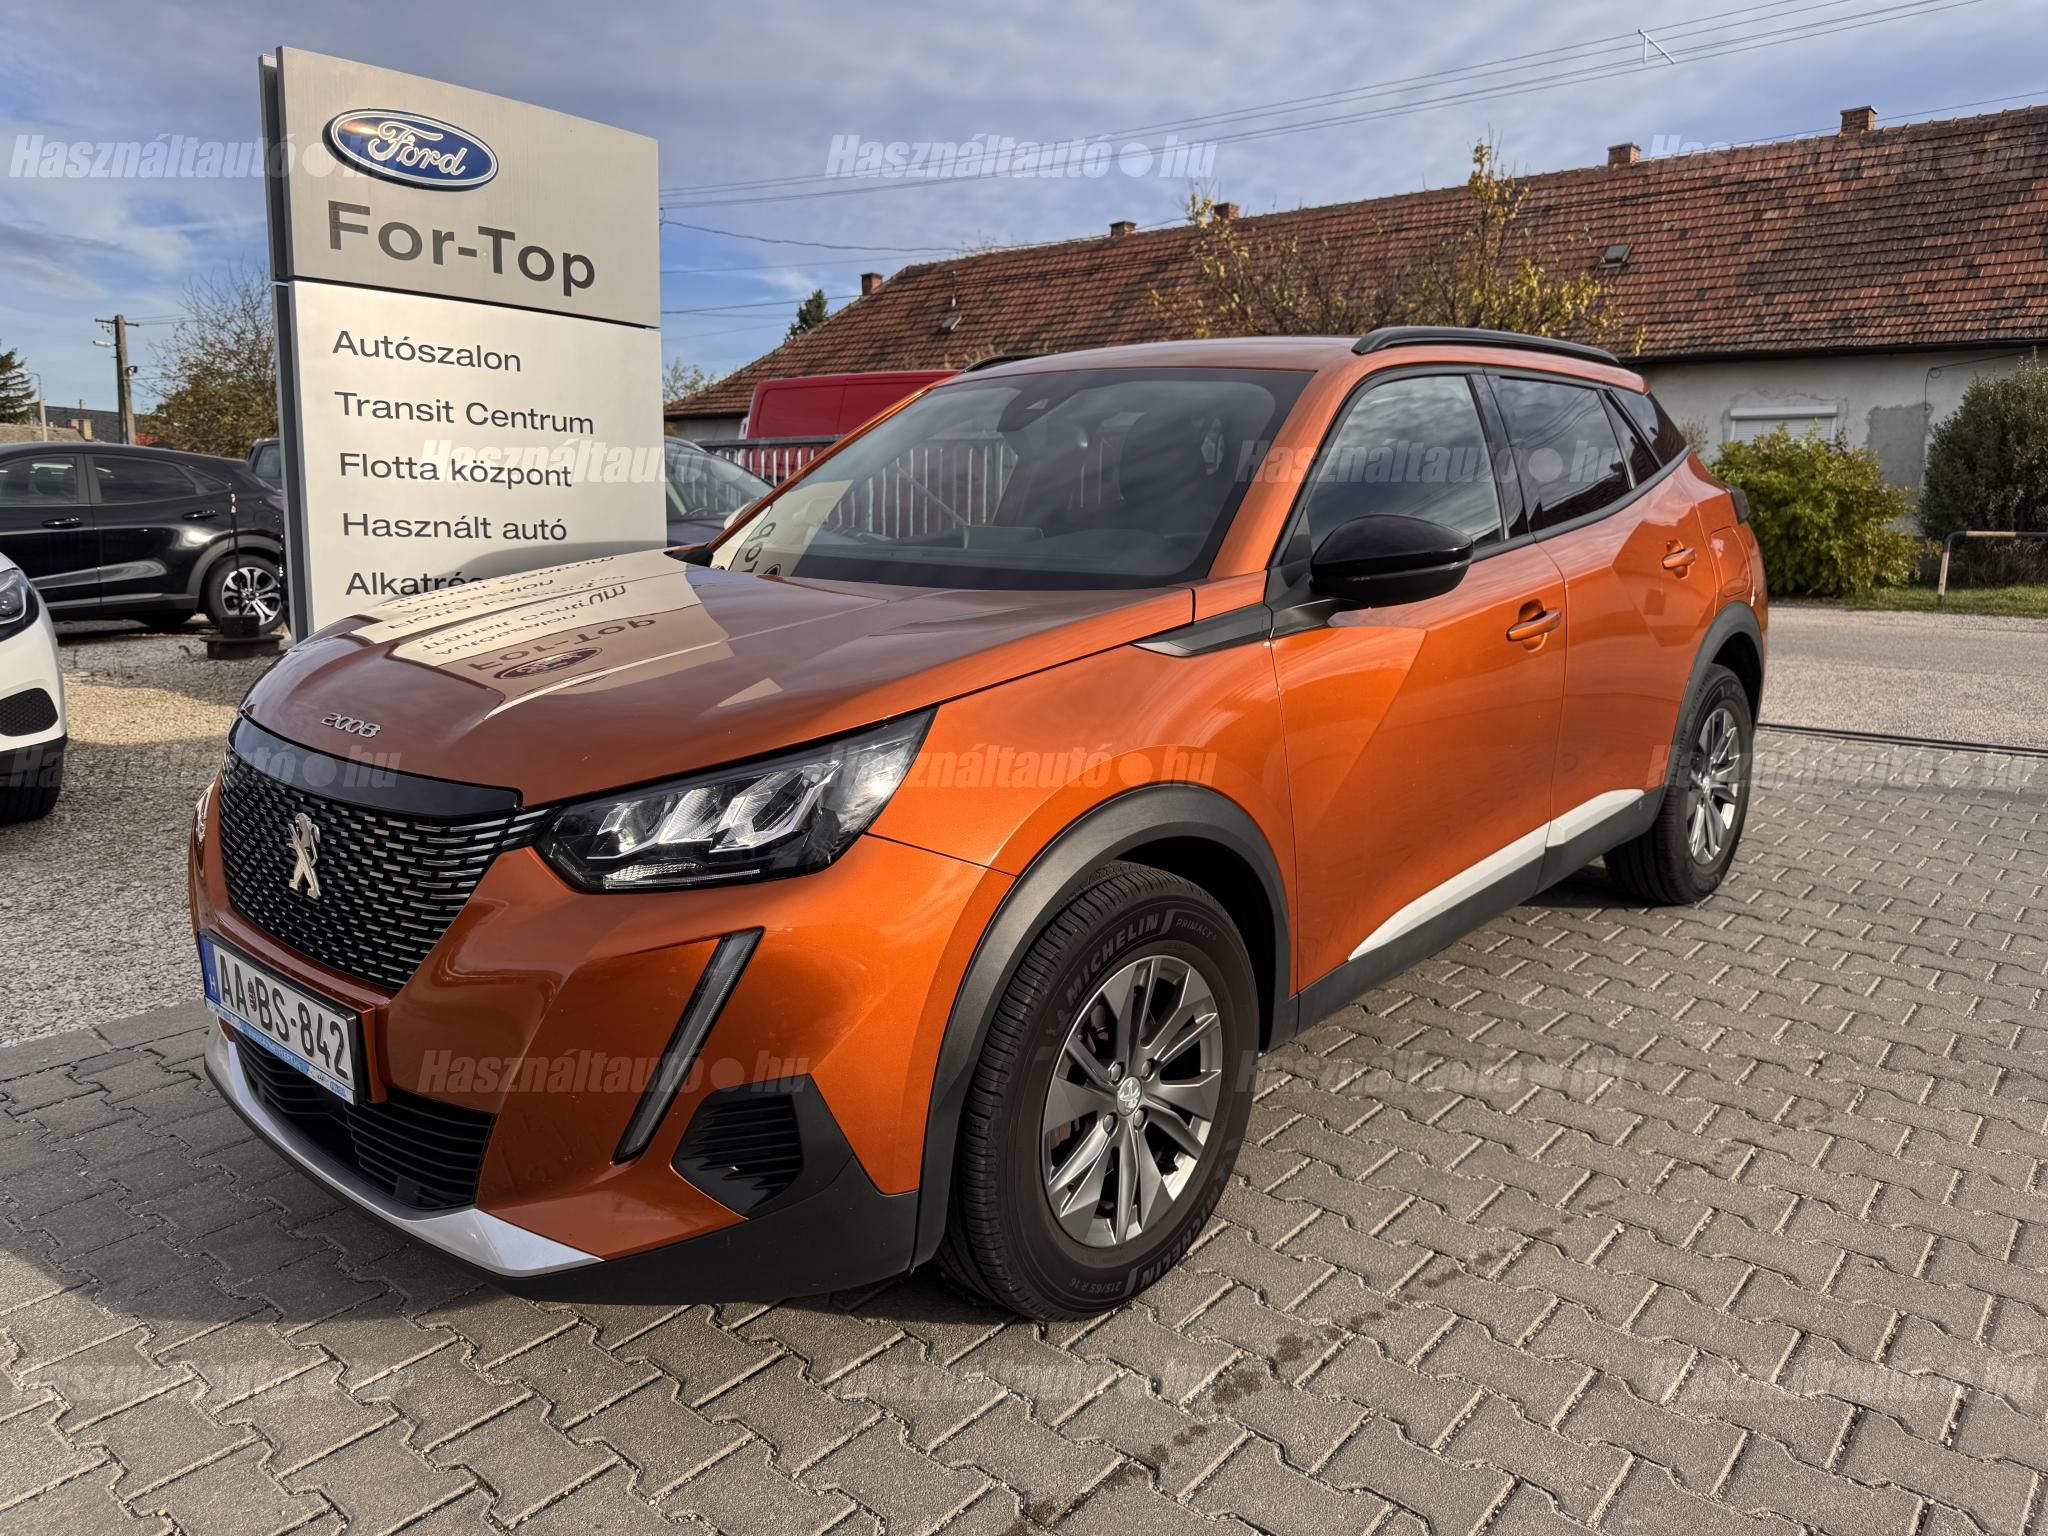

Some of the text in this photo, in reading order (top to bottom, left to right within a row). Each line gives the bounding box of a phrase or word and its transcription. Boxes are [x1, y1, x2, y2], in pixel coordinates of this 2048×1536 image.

[367, 119, 468, 178] Ford
[327, 199, 597, 297] For-Top
[332, 330, 522, 373] Autószalon
[334, 391, 595, 436] Transit Centrum
[339, 453, 573, 489] Flotta központ
[342, 513, 568, 542] Használt autó
[345, 571, 484, 596] Alkatré
[320, 712, 382, 739] 2008
[1065, 912, 1160, 1007] MICHELIN
